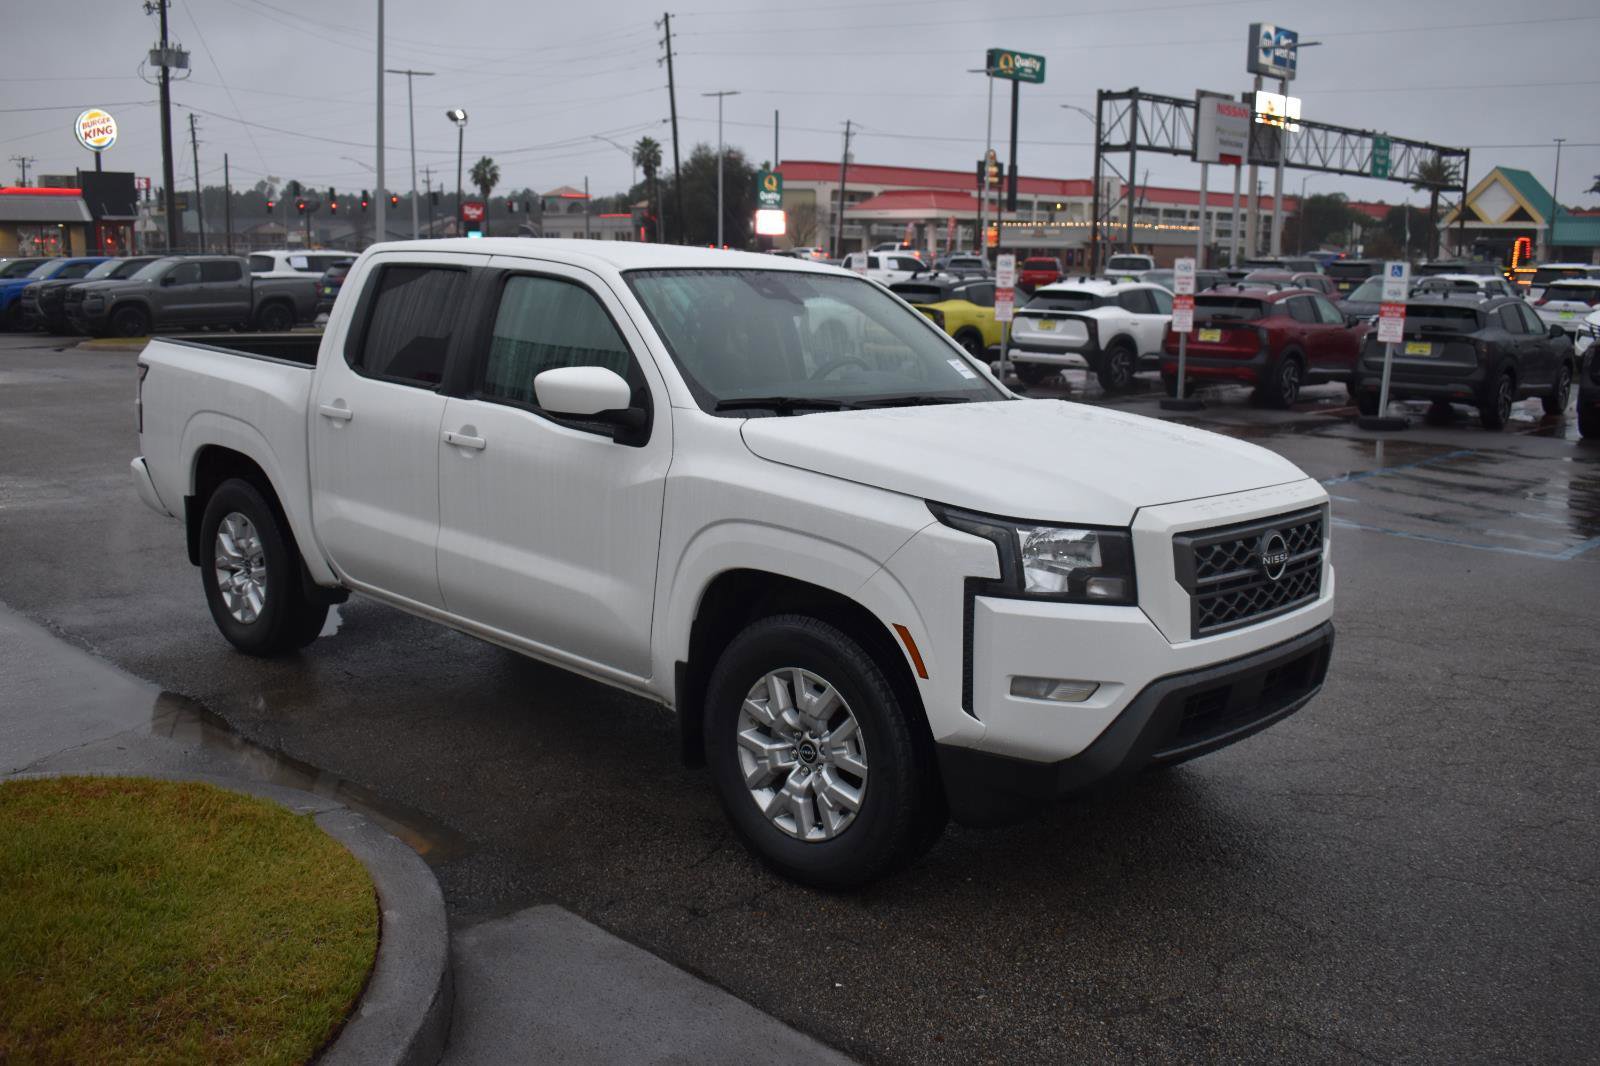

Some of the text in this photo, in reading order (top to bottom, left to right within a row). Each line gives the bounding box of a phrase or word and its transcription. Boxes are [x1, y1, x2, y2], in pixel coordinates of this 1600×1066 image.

[1014, 54, 1041, 72] Quality
[1216, 103, 1249, 119] NISSAN
[82, 117, 111, 130] BURGER
[84, 125, 113, 141] KING
[760, 190, 780, 202] Quality
[1262, 552, 1288, 565] NISS
